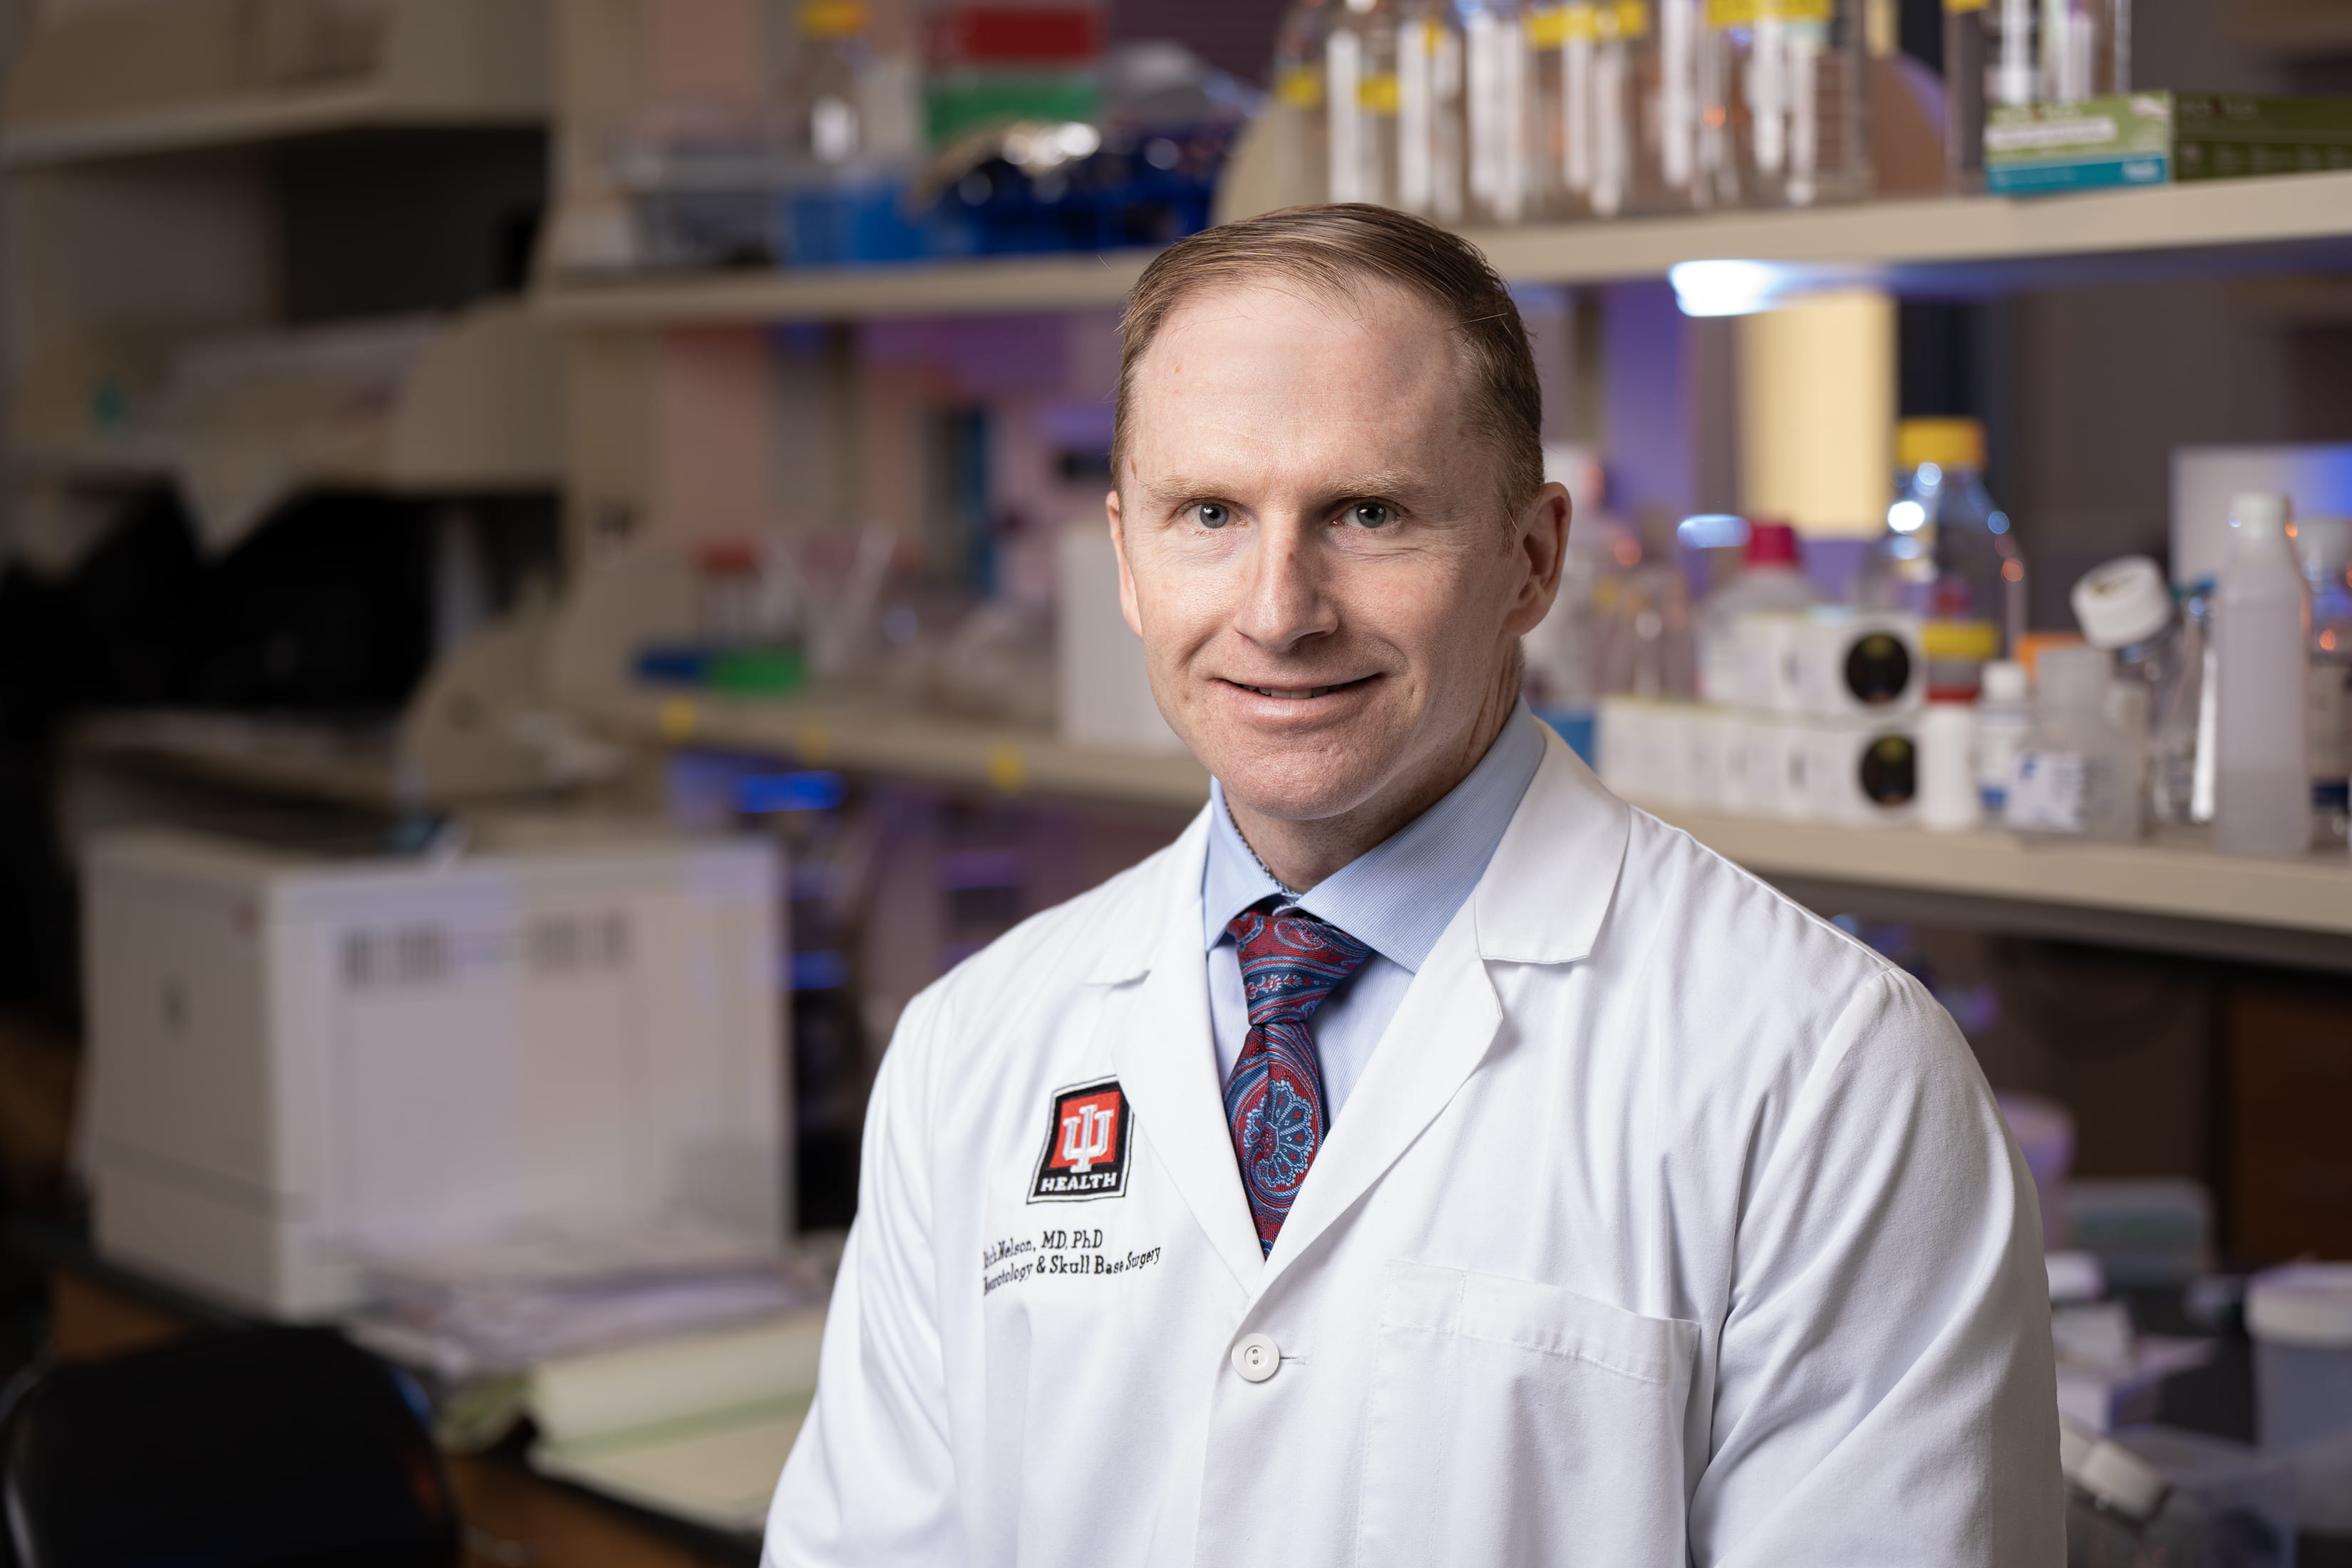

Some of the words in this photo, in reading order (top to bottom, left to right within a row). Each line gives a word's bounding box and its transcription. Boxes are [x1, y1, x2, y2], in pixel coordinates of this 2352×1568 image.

[1040, 1172, 1118, 1192] HEALTH
[998, 1237, 1036, 1260] Nelson,
[1041, 1230, 1068, 1250] MD,
[1071, 1229, 1103, 1249] PhD
[1036, 1255, 1046, 1274] &
[1049, 1254, 1090, 1274] Skull
[1093, 1255, 1124, 1274] Base
[1125, 1247, 1160, 1269] Surgery
